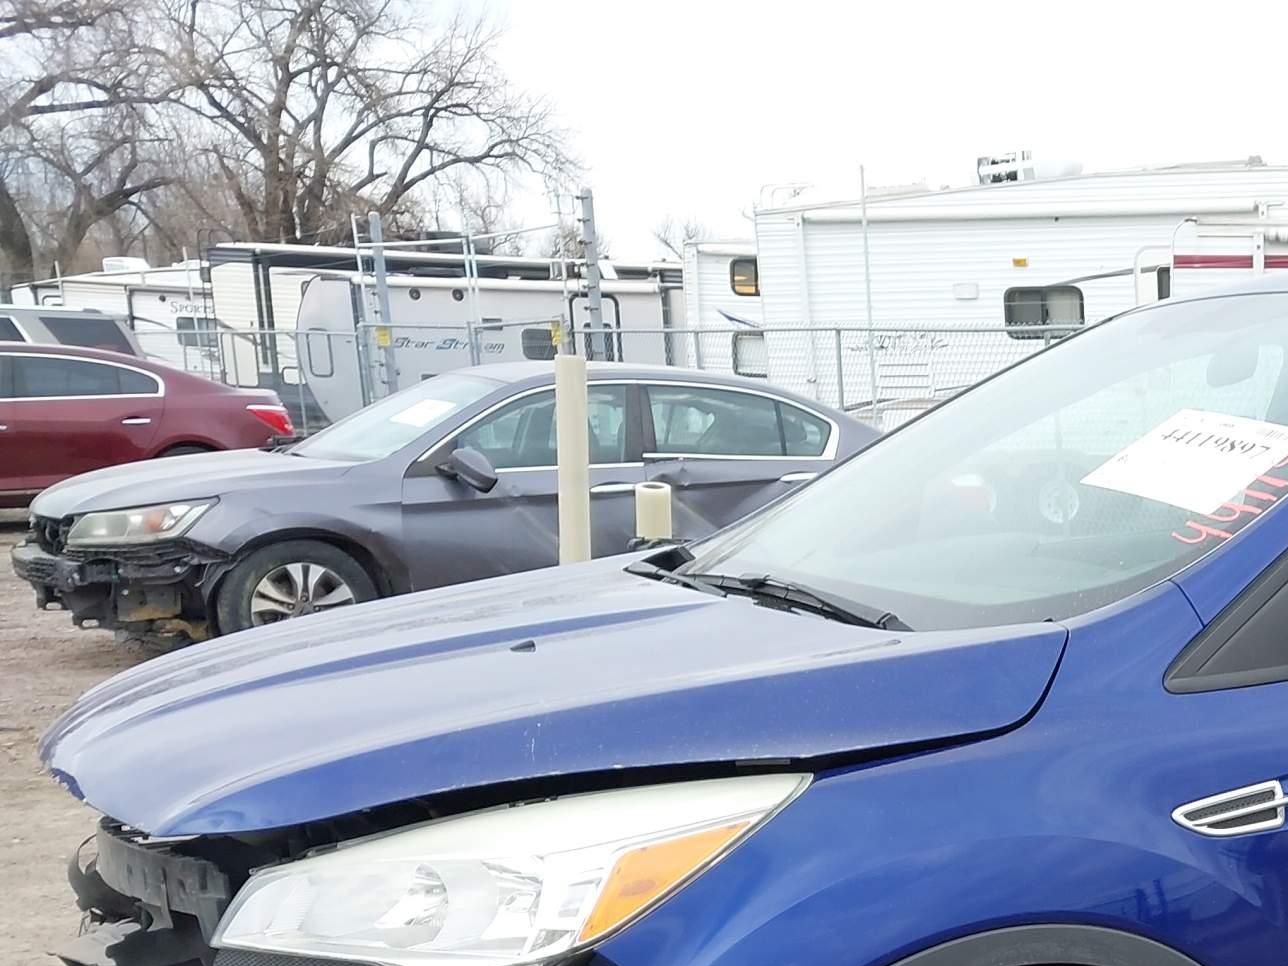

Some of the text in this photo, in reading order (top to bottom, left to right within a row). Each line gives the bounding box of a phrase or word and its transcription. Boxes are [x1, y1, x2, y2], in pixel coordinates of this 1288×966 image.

[393, 336, 505, 354] Star Stram
[1160, 428, 1271, 459] 44119897
